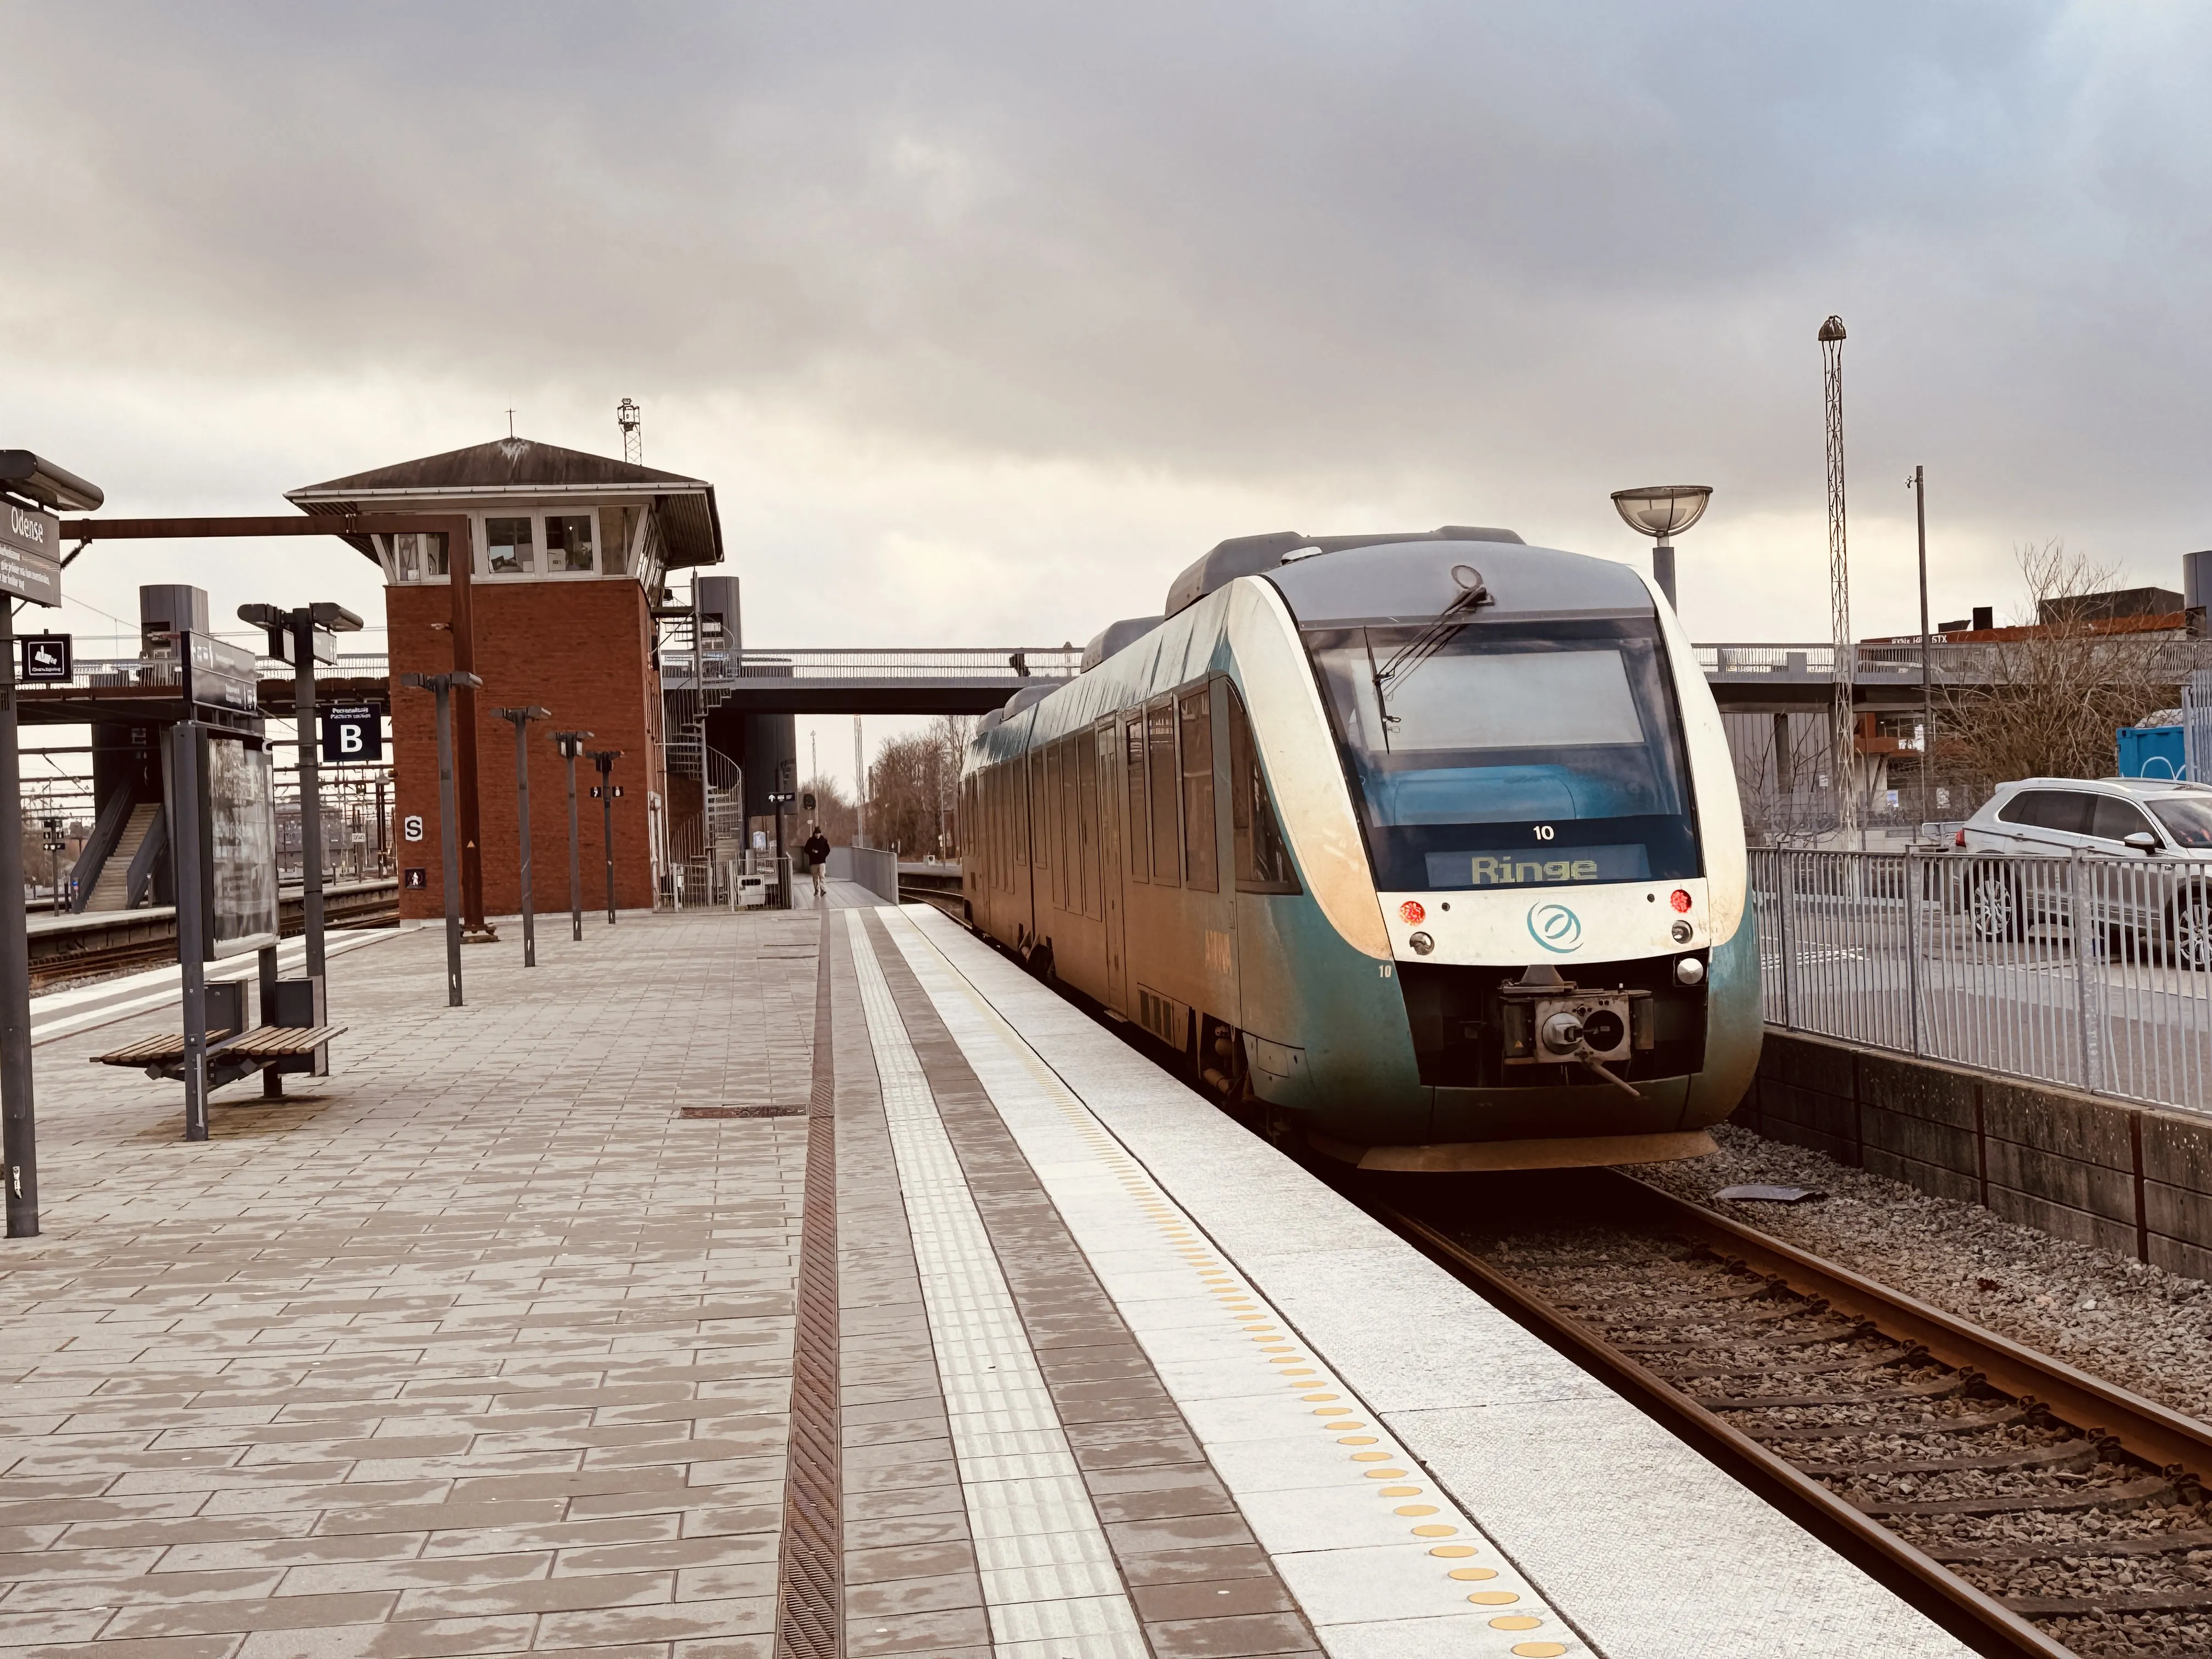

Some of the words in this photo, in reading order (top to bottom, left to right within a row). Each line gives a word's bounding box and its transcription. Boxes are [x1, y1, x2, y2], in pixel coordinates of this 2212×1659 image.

[11, 506, 43, 544] Odense
[340, 724, 363, 753] B
[407, 820, 421, 837] S
[1533, 825, 1554, 840] 10
[1471, 856, 1598, 884] Ringe
[1379, 964, 1392, 978] 10
